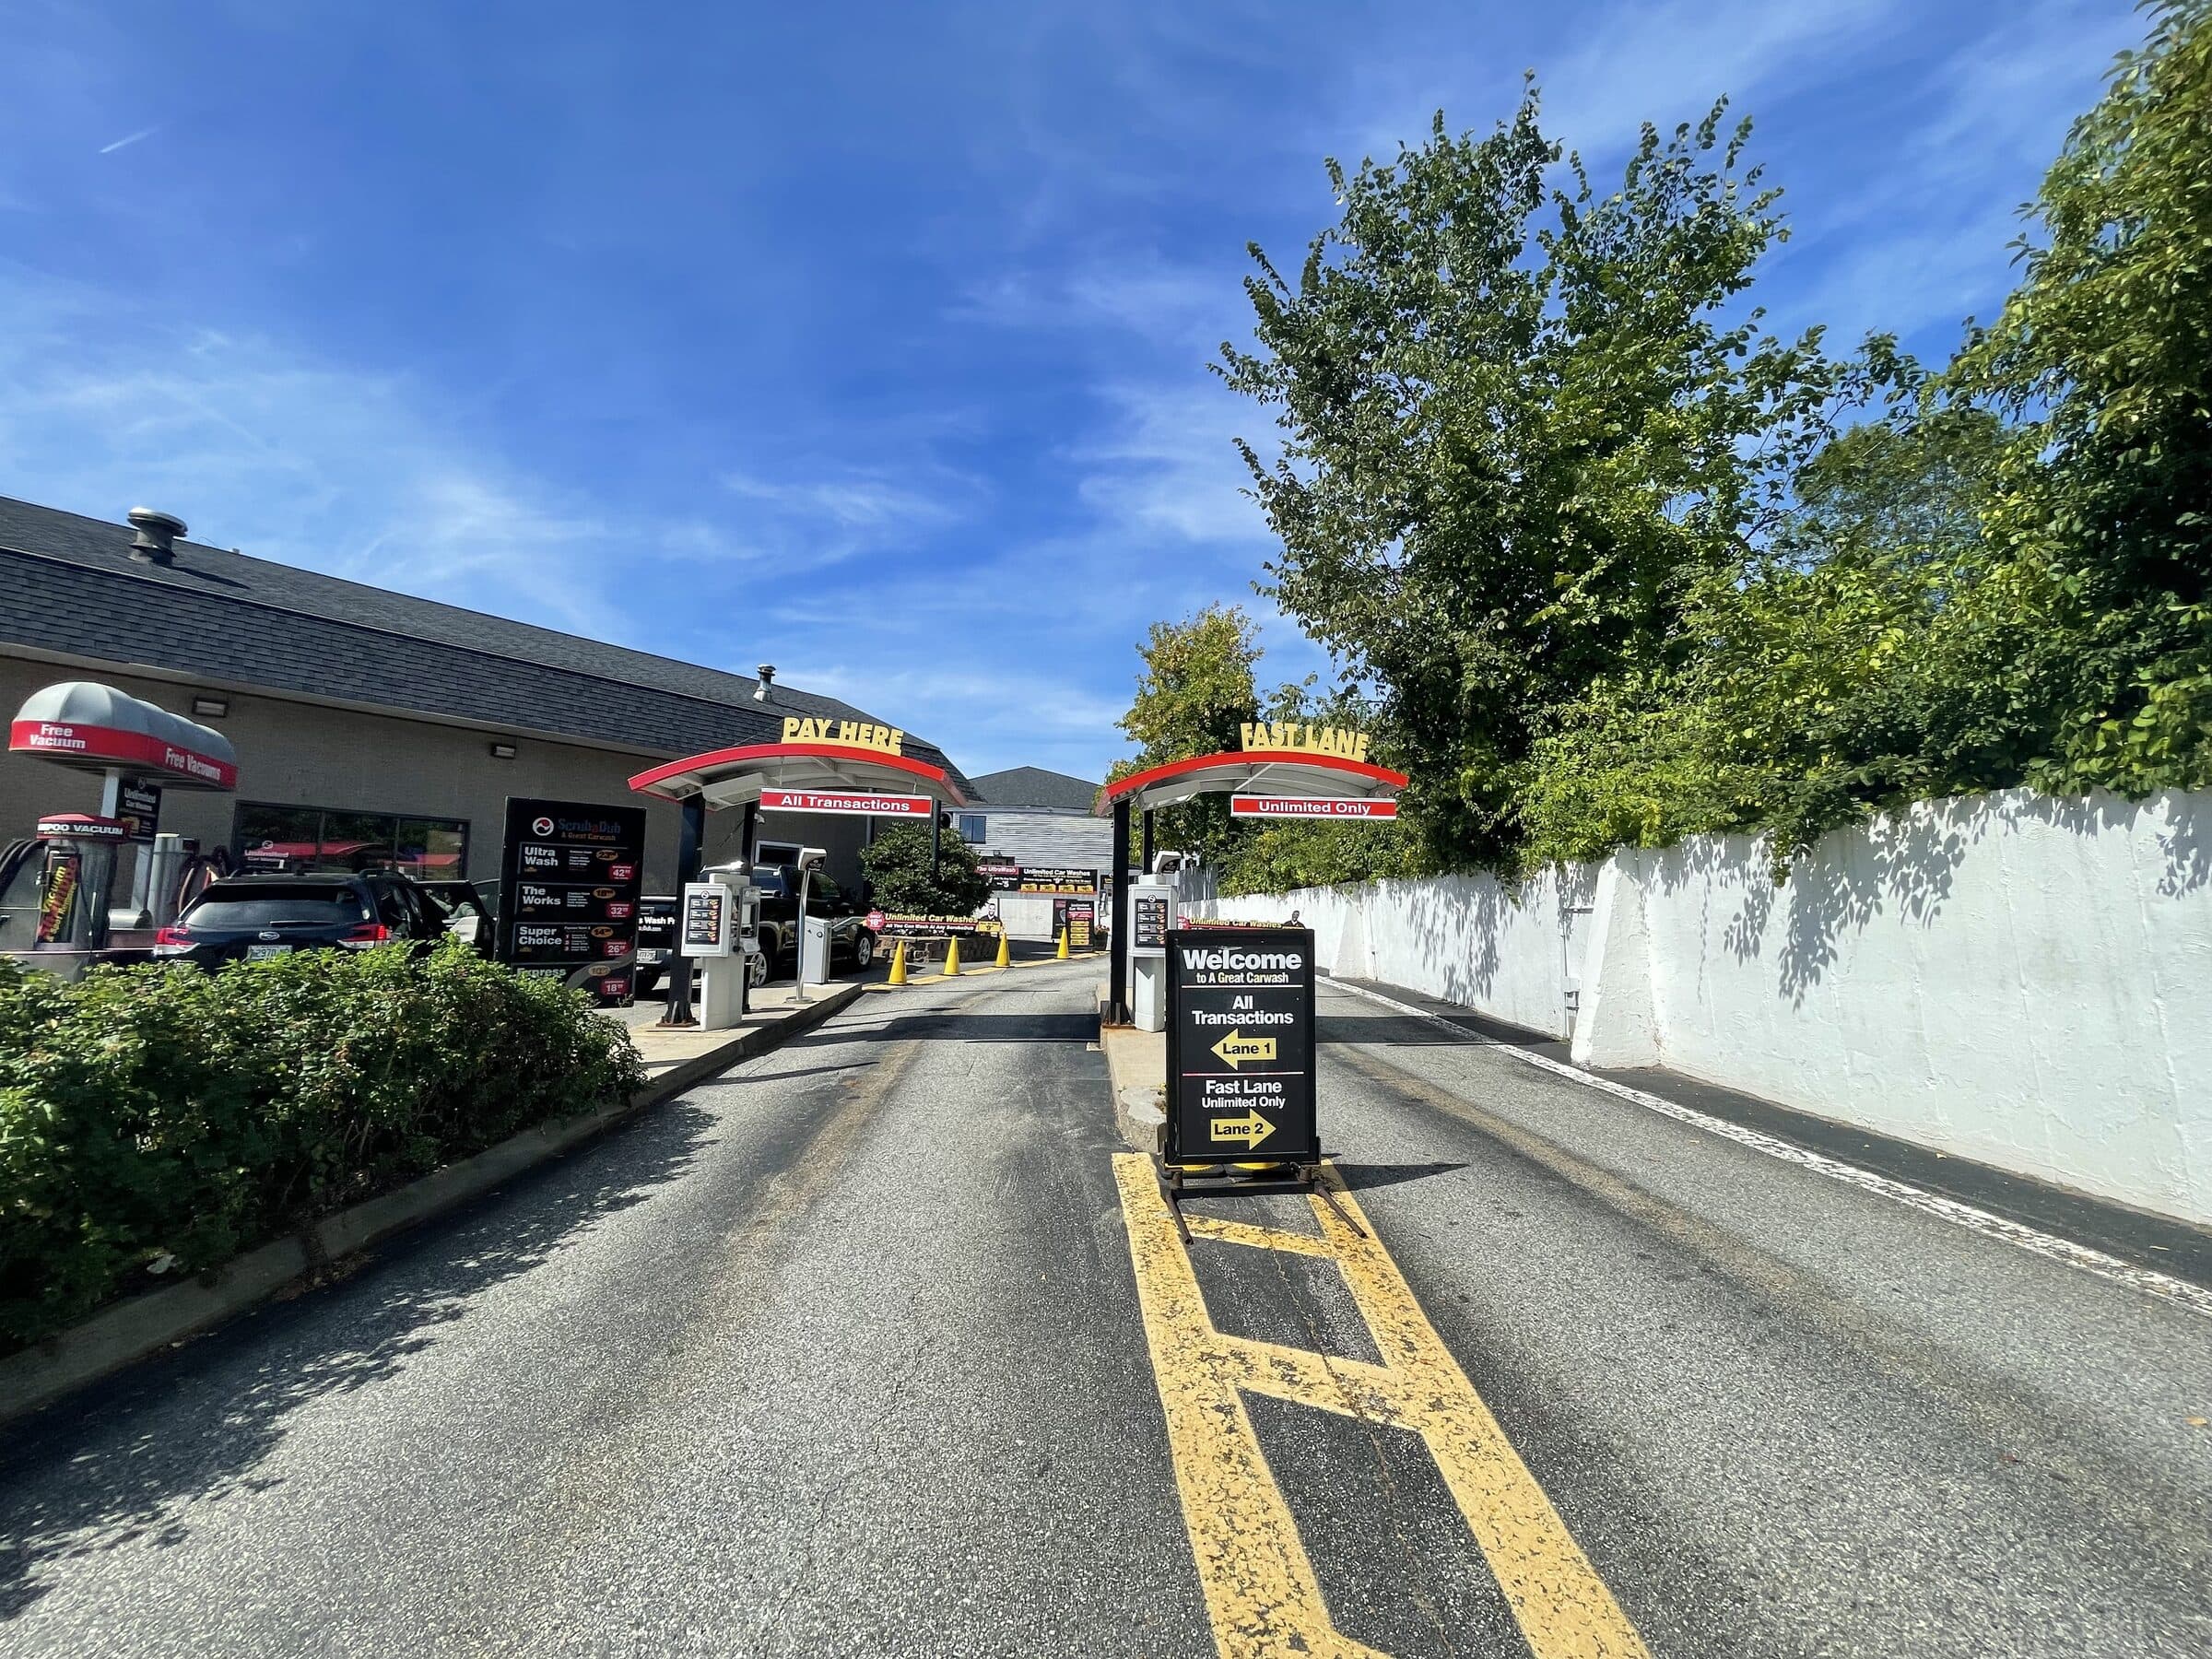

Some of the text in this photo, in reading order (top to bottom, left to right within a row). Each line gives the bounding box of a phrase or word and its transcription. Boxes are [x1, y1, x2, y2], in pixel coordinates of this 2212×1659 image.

[41, 724, 73, 737] Free
[782, 717, 904, 754] PAY HERE
[29, 734, 87, 749] Vacuum
[1240, 722, 1370, 758] FAST LANE
[165, 747, 222, 782] Free Vacuums
[782, 794, 911, 811] All Transactions
[1259, 801, 1371, 816] Unlimited Only
[73, 824, 124, 835] VACUUM
[524, 846, 556, 857] Ultra
[524, 855, 559, 866] Wash
[523, 886, 546, 896] The
[523, 896, 561, 905] Works
[644, 916, 666, 924] Wash
[885, 912, 926, 922] Unlimited
[928, 914, 944, 923] Car
[1189, 917, 1230, 926] Unlimited
[1249, 920, 1282, 929] Washes
[519, 926, 557, 937] Super
[519, 936, 562, 946] Choice
[1182, 949, 1302, 970] Welcome
[1196, 971, 1288, 983] to A Great Carwash
[1232, 995, 1253, 1009] All
[1192, 1010, 1294, 1025] Transactions
[1222, 1042, 1271, 1054] Lane 1
[1206, 1079, 1282, 1094] Fast Lane
[1202, 1096, 1286, 1109] Unlimited Only
[1214, 1123, 1264, 1135] Lane 2
